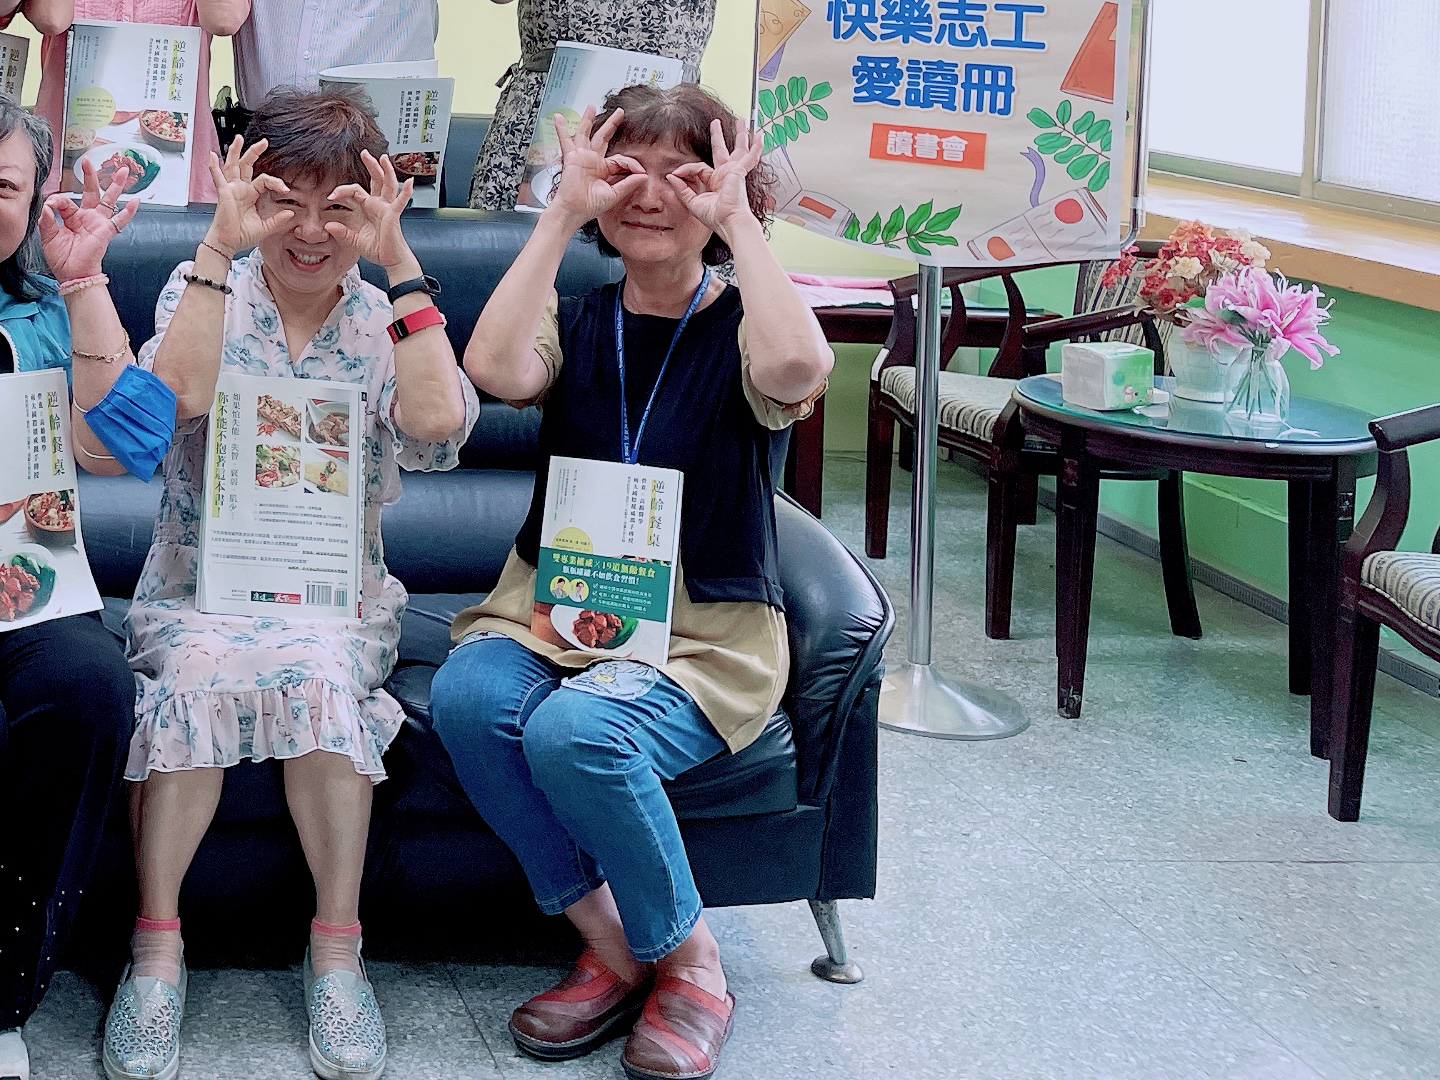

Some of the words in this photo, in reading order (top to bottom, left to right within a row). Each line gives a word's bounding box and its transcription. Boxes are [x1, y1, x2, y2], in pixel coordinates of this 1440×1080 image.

[6, 49, 20, 94] 逆齡餐
[851, 55, 1016, 116] 愛讀冊
[886, 128, 968, 162] 讀書會
[48, 392, 65, 476] 逆齡餐桌
[648, 480, 665, 547] 逆齡餐桌
